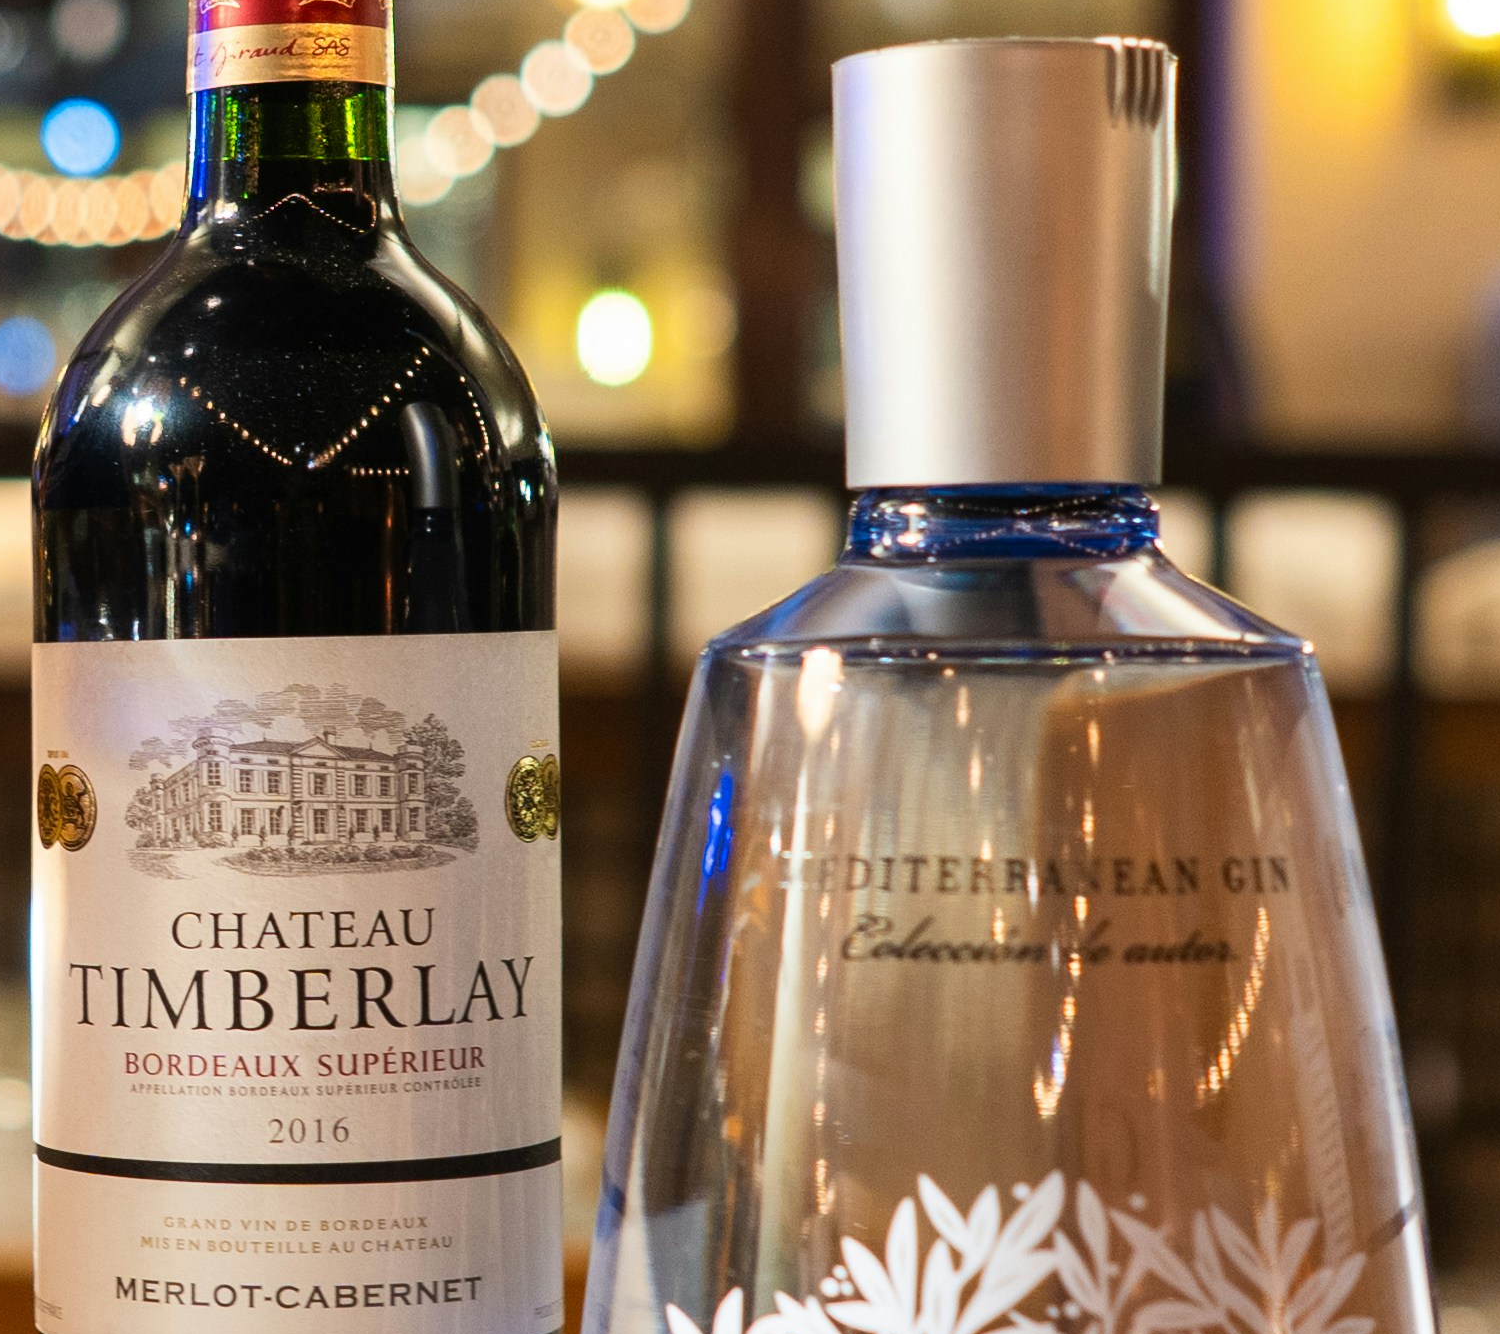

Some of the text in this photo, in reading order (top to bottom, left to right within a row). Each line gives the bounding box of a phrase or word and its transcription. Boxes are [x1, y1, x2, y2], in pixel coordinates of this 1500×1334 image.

[210, 38, 304, 78] Giraud
[312, 36, 351, 57] SAS
[1220, 855, 1291, 895] GIN
[171, 907, 437, 951] CHATEAU
[68, 956, 535, 1033] TIMBERLAY
[124, 1046, 486, 1078] BORDEAUX SUPÉRIEUR
[129, 1083, 223, 1097] APPELLATION
[229, 1085, 310, 1098] BORDEAUX
[267, 1115, 351, 1145] 2016
[163, 1216, 430, 1233] GRAND VIN DE BORDEAUX
[140, 1236, 454, 1255] MIS EN BOUTEILLE AU CHATEAU
[114, 1275, 483, 1310] MERLOT-CABERNET
